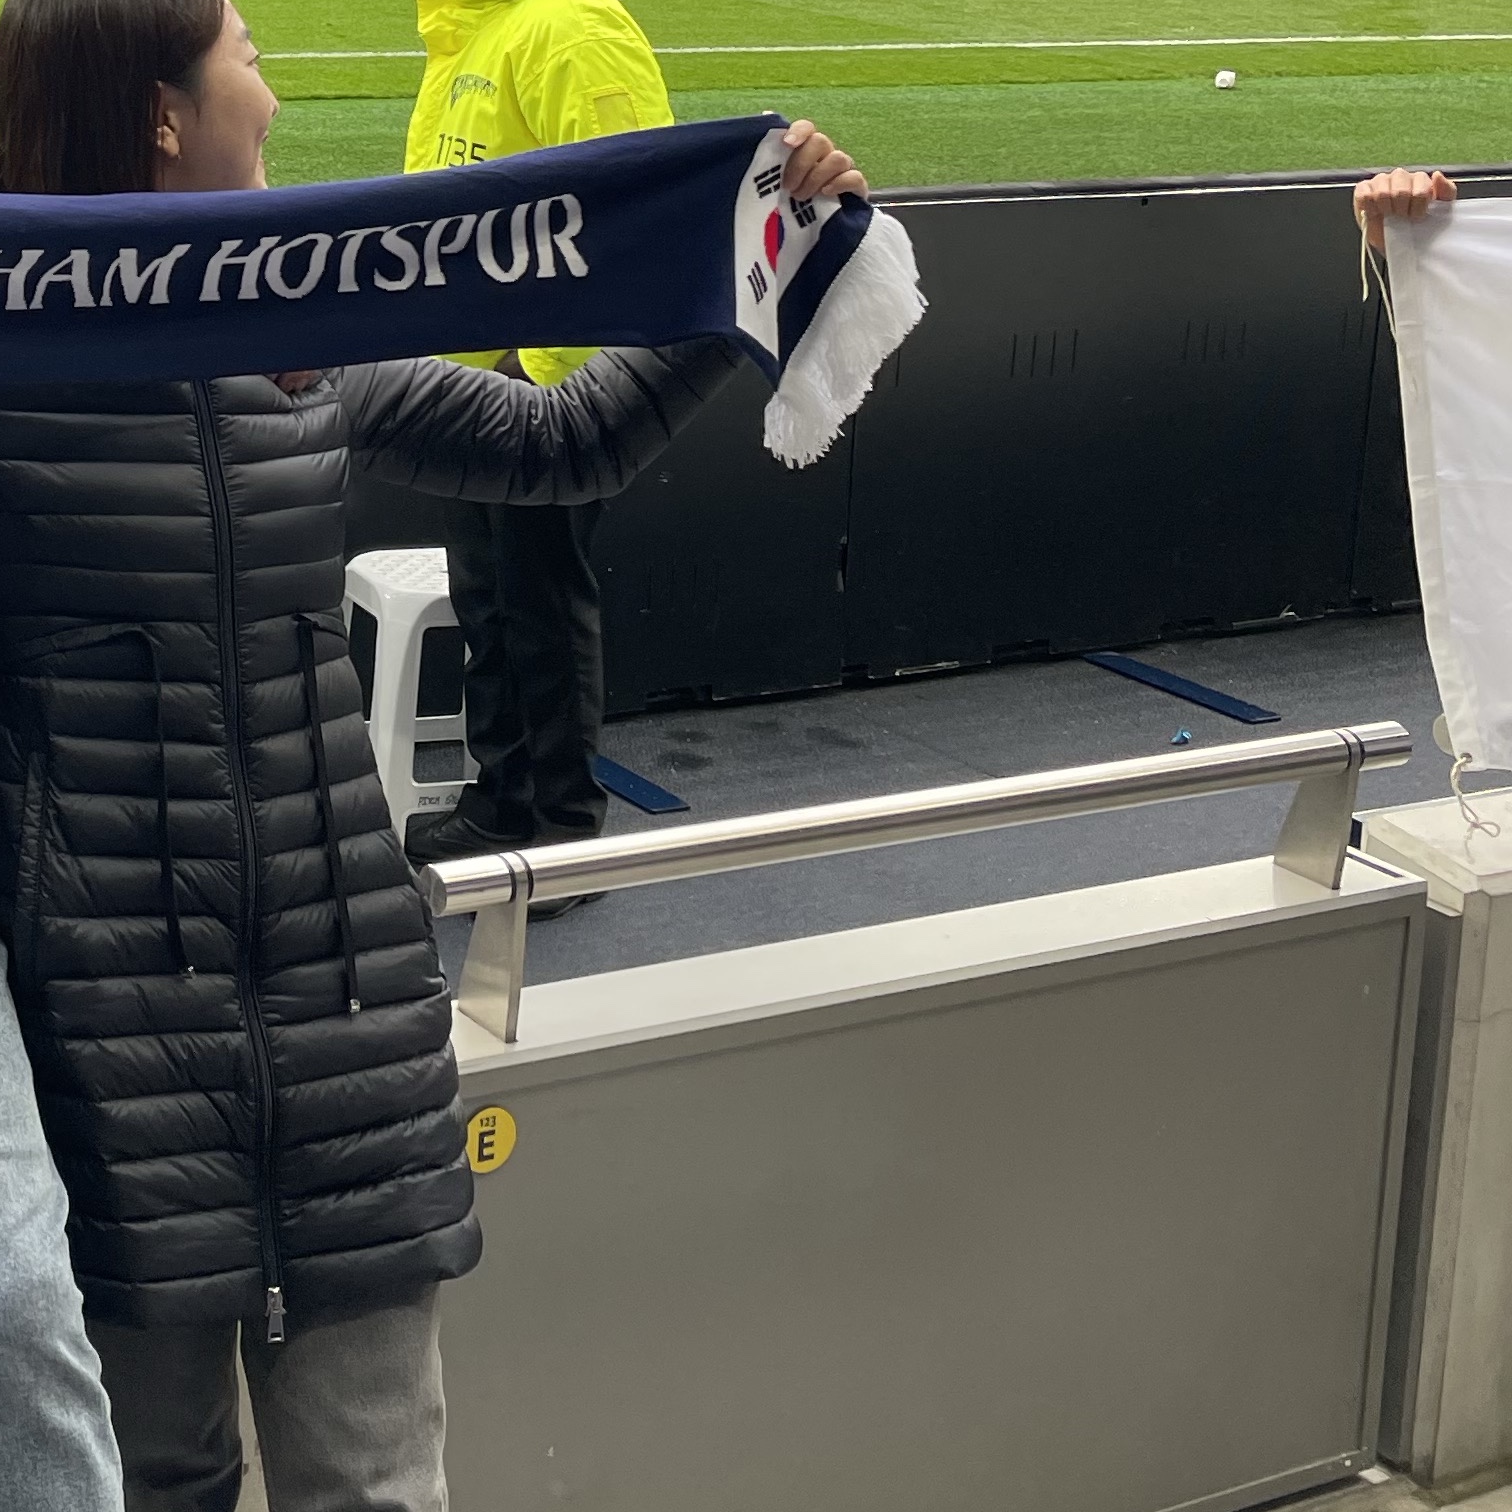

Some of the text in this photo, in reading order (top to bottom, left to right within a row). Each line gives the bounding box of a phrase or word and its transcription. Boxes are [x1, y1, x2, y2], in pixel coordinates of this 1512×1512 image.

[437, 133, 487, 167] 1135
[199, 192, 590, 304] HOTSPUR
[479, 1115, 497, 1128] 123
[477, 1129, 496, 1164] E
